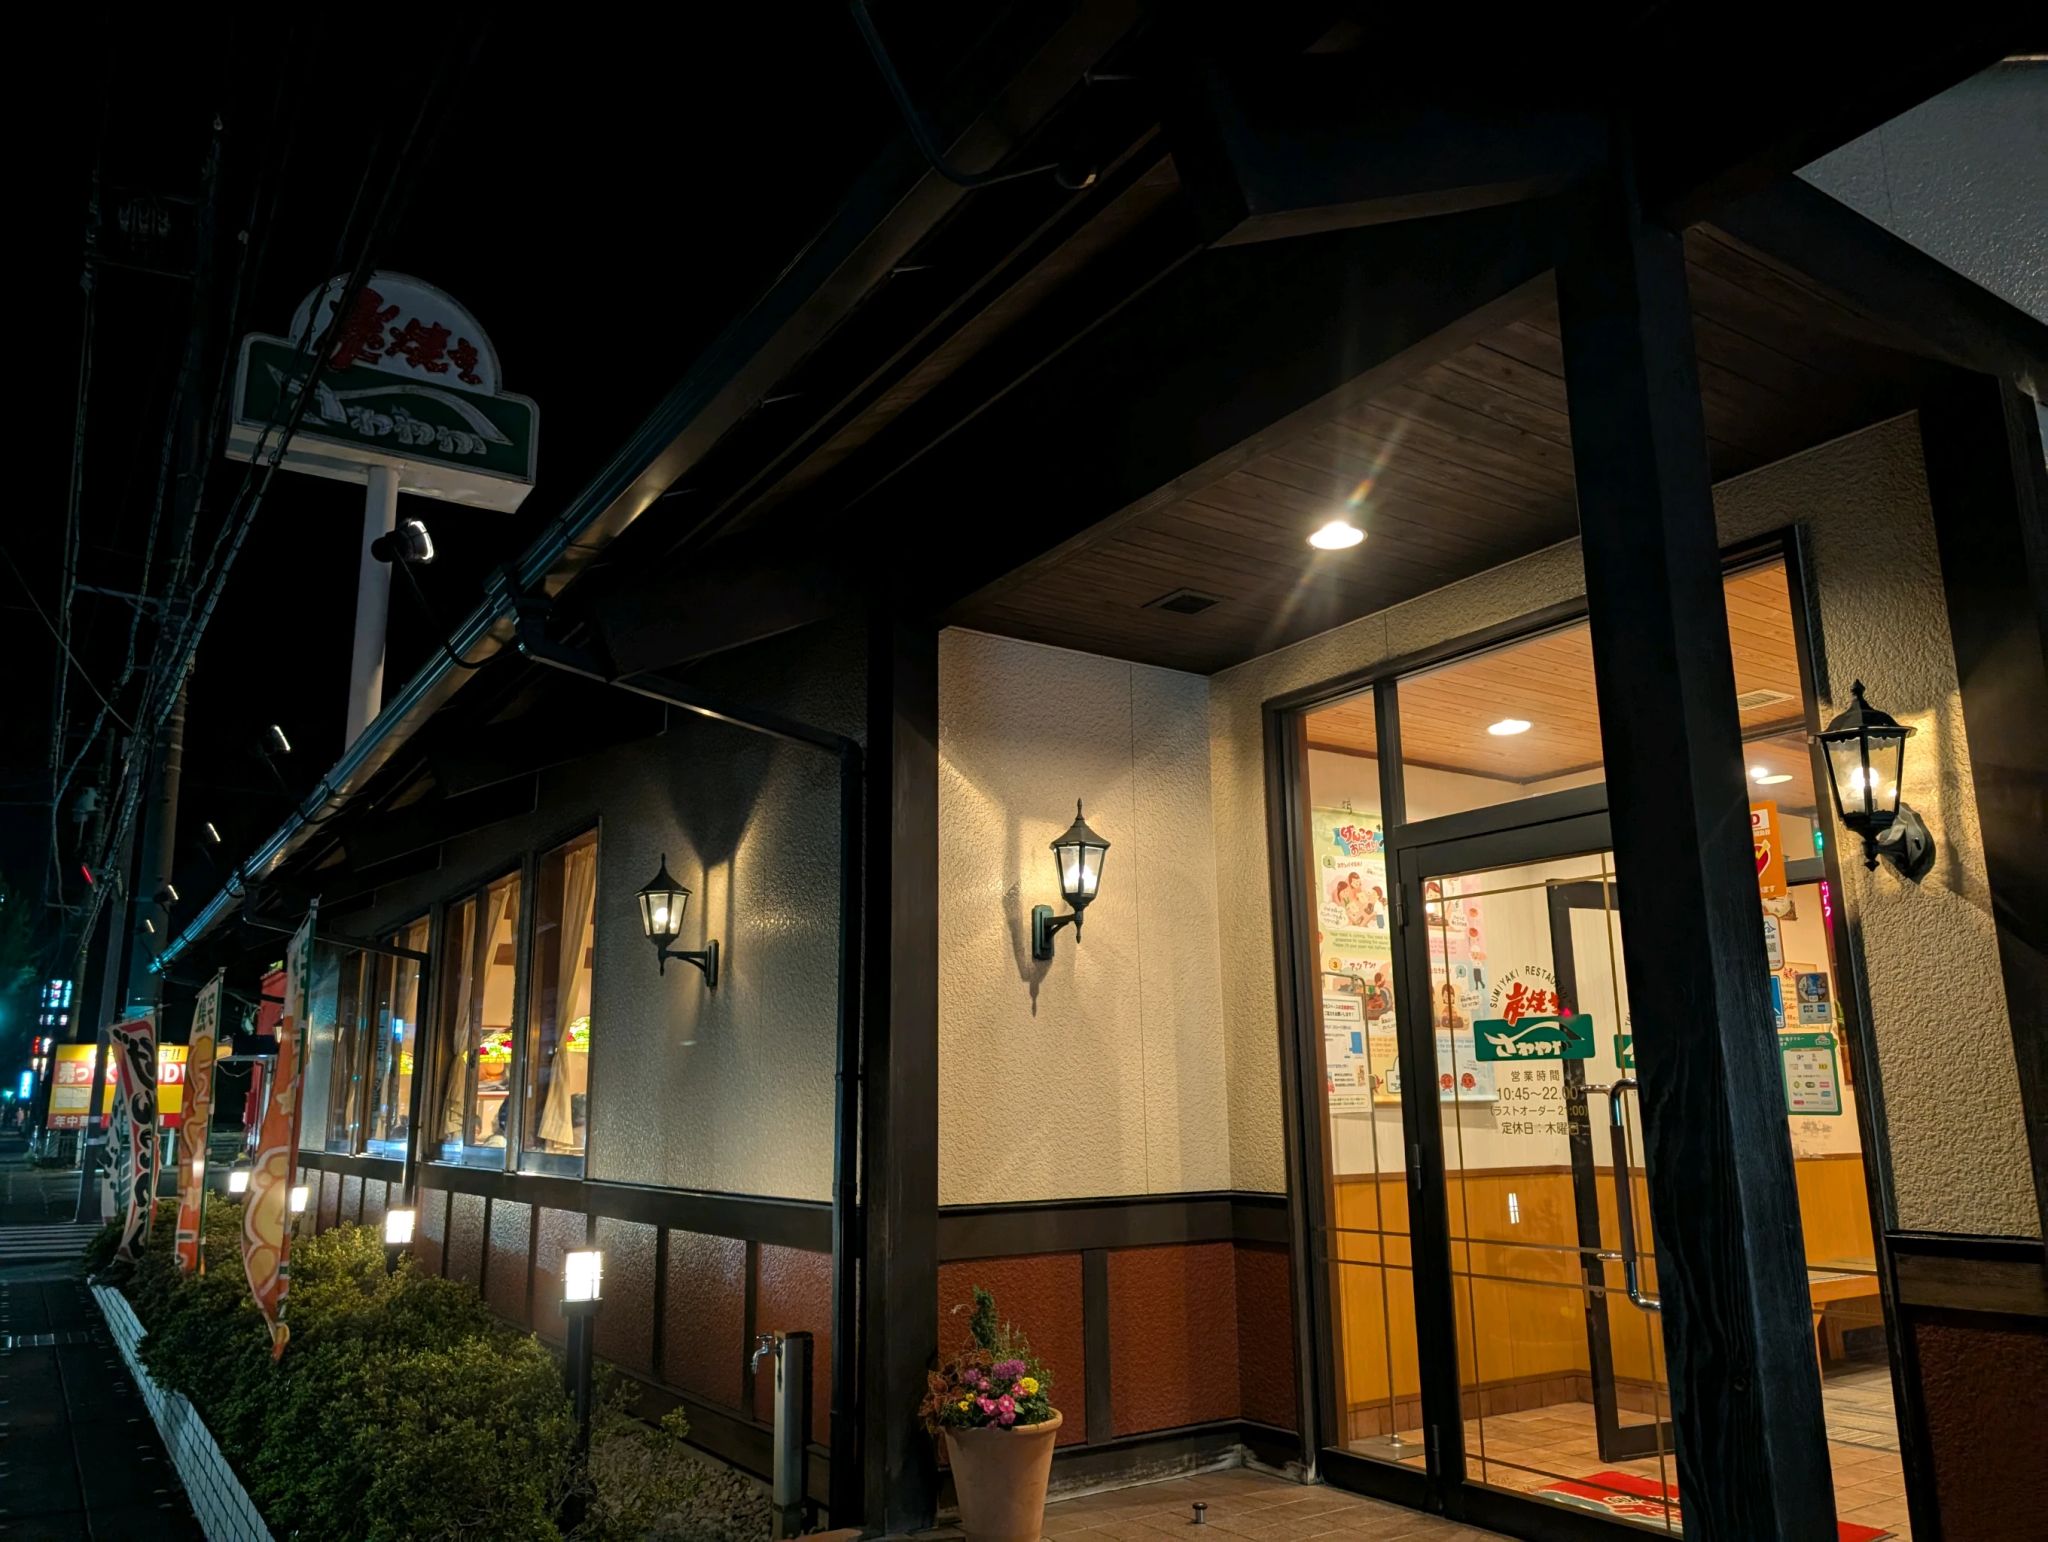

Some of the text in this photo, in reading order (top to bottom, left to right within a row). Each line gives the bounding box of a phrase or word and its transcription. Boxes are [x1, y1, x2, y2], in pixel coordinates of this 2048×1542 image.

[316, 287, 482, 386] 炭焼き
[265, 362, 514, 455] さわやか
[1490, 968, 1519, 1009] SUMIYAKI
[1503, 982, 1561, 1027] 炭焼き
[1510, 1070, 1560, 1083] 営業時間
[1490, 1104, 1588, 1117] (ラストオーダー2:00)
